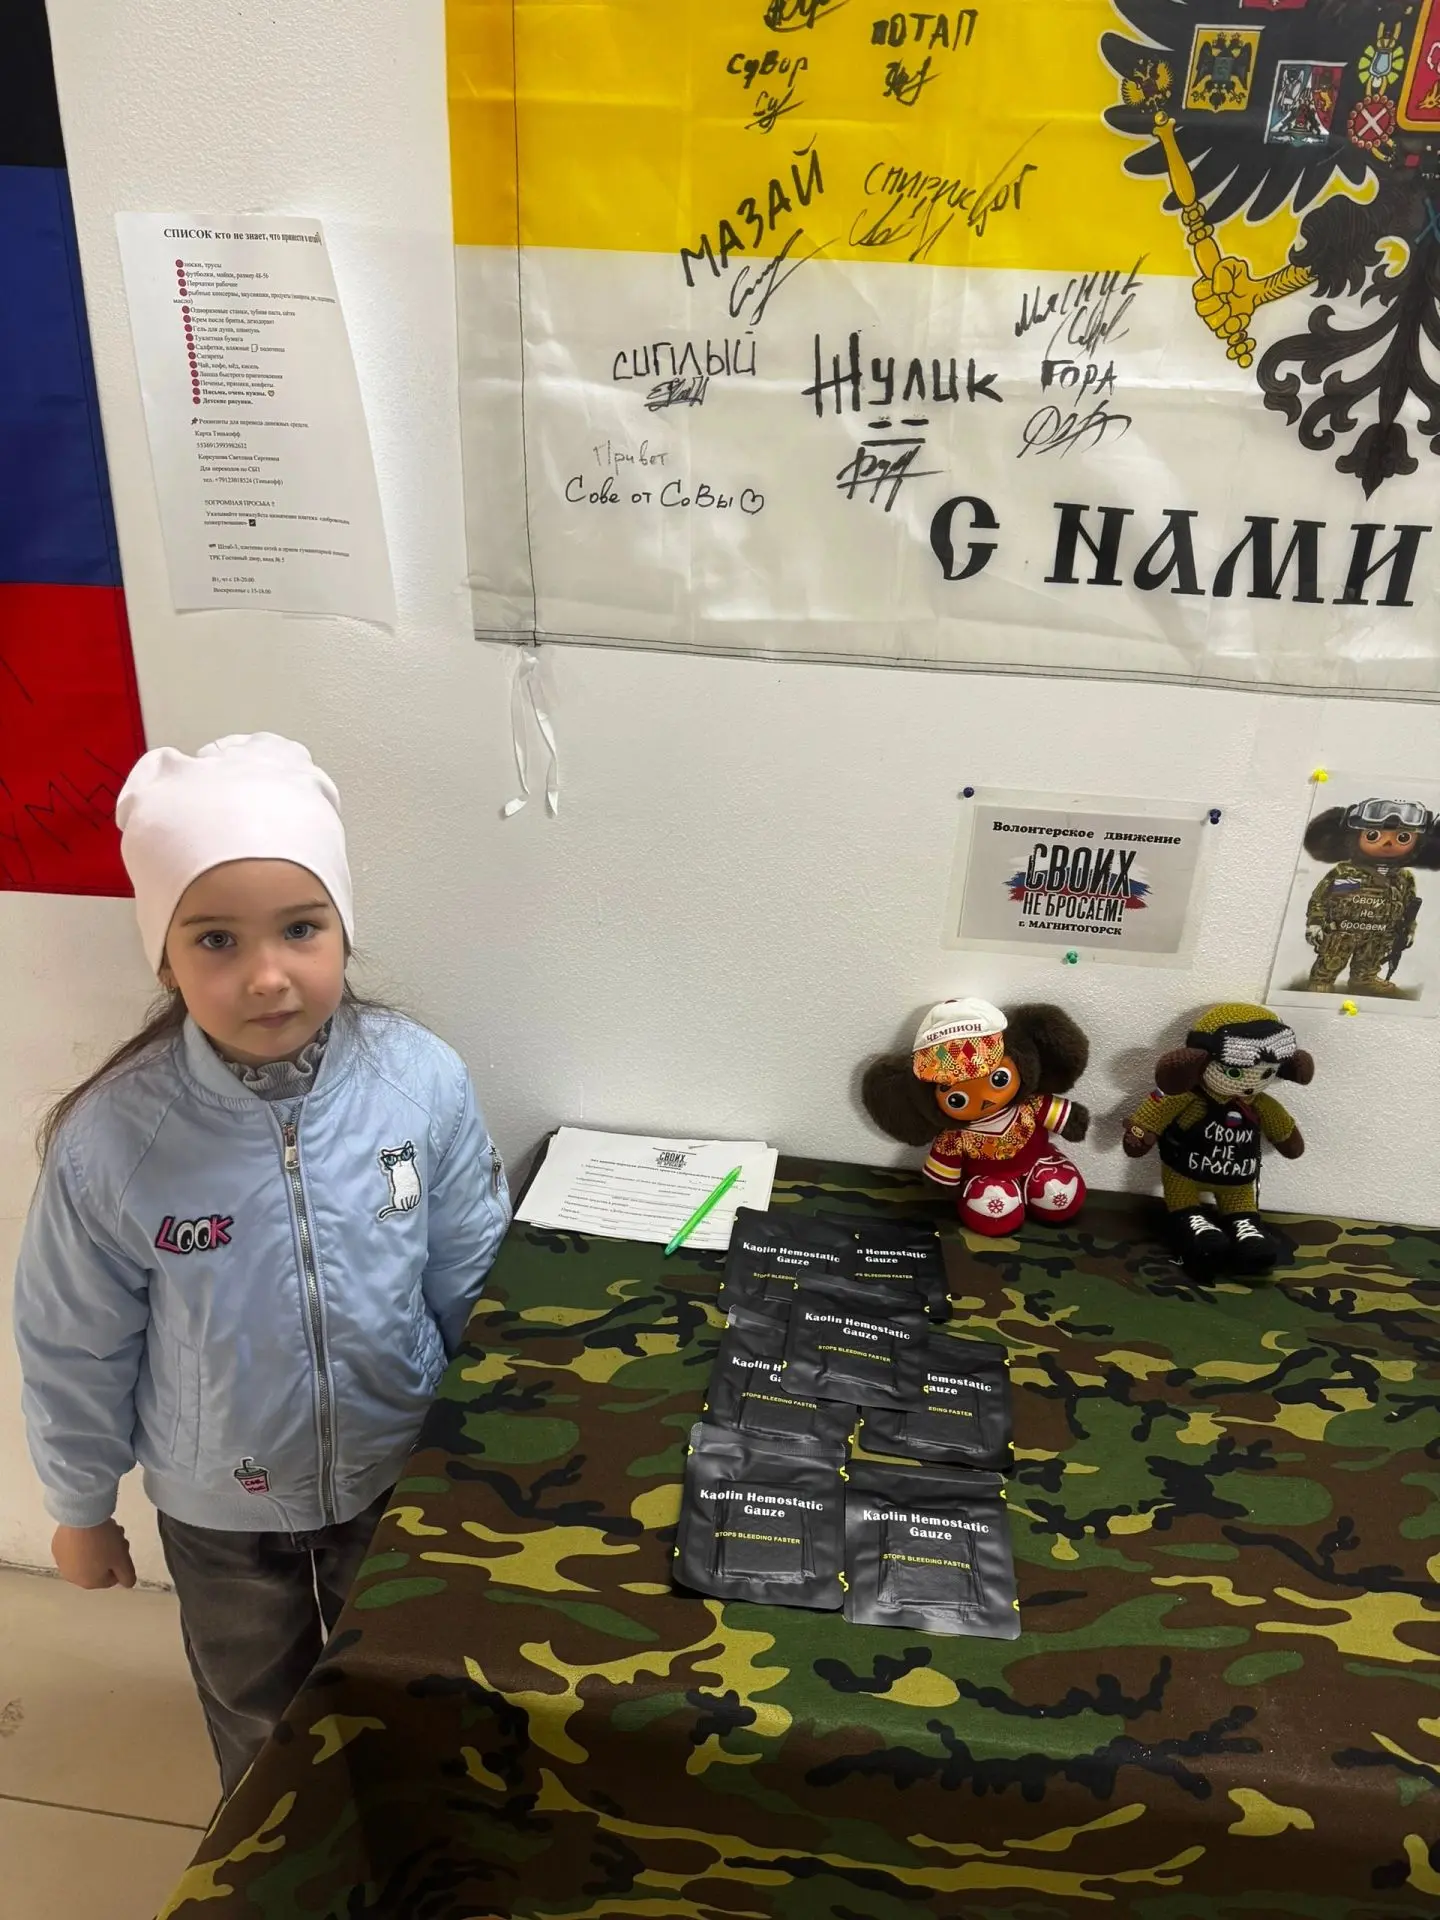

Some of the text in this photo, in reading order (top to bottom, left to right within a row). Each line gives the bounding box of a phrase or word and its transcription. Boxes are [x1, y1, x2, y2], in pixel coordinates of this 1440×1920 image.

[680, 133, 824, 286] МАЗАЙ
[164, 228, 212, 239] СПИСОК
[233, 232, 244, 240] не
[246, 233, 268, 241] знает,
[269, 233, 281, 241] что
[593, 439, 669, 475] Привет
[565, 475, 621, 504] Сове
[631, 491, 653, 504] от
[929, 495, 1433, 607] С НАМИ
[993, 822, 1181, 844] Волонтерское движение
[1025, 843, 1137, 898] СВОИХ
[1023, 892, 1124, 922] НЕ БРОСАЕМ!
[1352, 894, 1385, 905] Своих
[1029, 920, 1122, 935] МАГНИТОГОРСК
[1340, 920, 1386, 931] бросаем
[926, 1023, 982, 1043] ЧЕМПИОН
[1204, 1121, 1253, 1143] СВОИХ
[1212, 1146, 1235, 1160] НЕ
[155, 1215, 233, 1254] LOOK
[743, 1242, 840, 1263] Kaolin Hemostatic
[865, 1256, 898, 1264] Gauze
[866, 1248, 927, 1259] Hemostatic
[777, 1256, 810, 1266] Gauze
[805, 1313, 911, 1340] Kaolin Hemostatic
[843, 1327, 878, 1341] Gauze
[838, 1347, 867, 1358] BLEEDING
[868, 1352, 891, 1363] FASTER
[732, 1356, 770, 1371] Kaolin
[923, 1384, 958, 1395] auze
[762, 1395, 792, 1405] BLEEDING
[792, 1399, 817, 1409] FASTER
[928, 1406, 973, 1417] EDING FASTER
[700, 1489, 824, 1511] Kaolin Hemostatic
[744, 1505, 785, 1518] Gauze
[863, 1510, 989, 1534] Kaolin Hemostatic
[715, 1530, 801, 1544] STOPS BLEEDING FASTER
[909, 1526, 953, 1541] Gauze
[883, 1552, 970, 1570] STOPS BLEEDING FASTER
